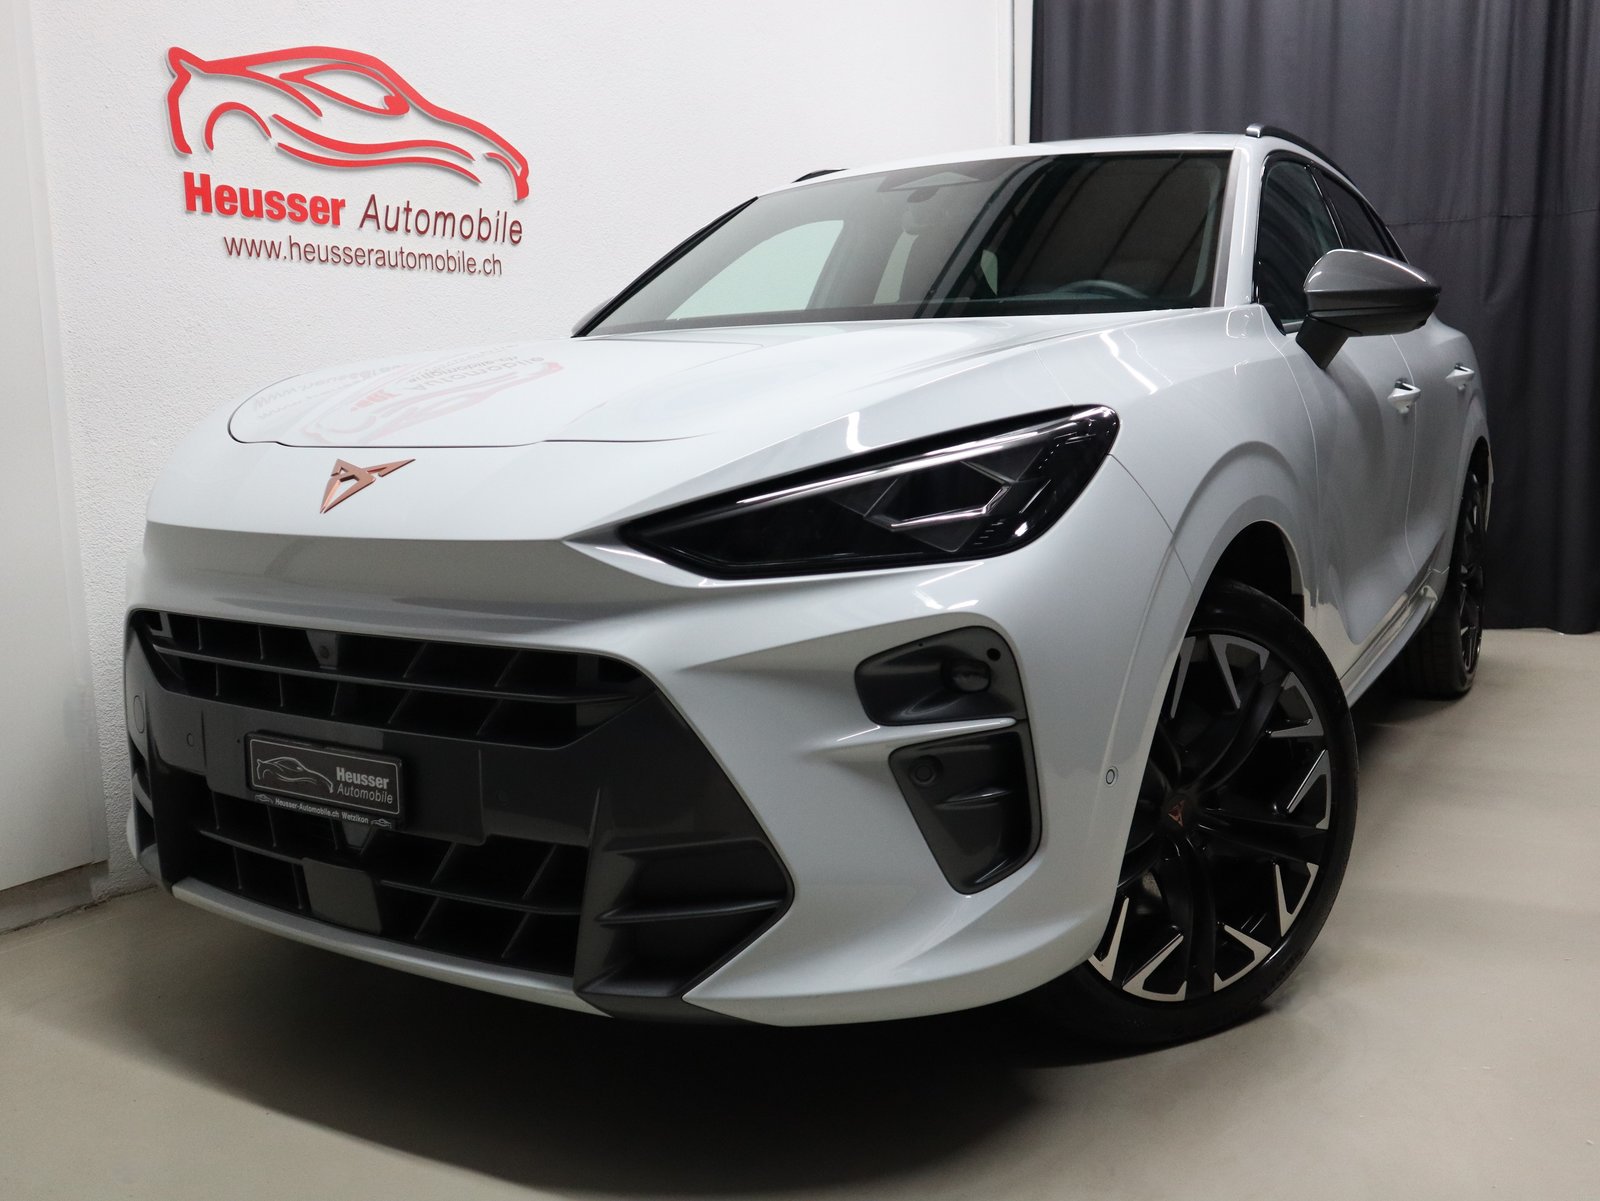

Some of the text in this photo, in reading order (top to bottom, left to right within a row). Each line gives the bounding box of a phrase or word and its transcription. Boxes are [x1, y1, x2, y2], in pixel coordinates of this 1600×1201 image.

[184, 172, 523, 244] Heusser Automobile
[223, 235, 502, 275] www.heusserautomobile.ch
[336, 767, 389, 789] Heusser
[337, 784, 393, 804] Automobile
[275, 798, 369, 824] Heusser-Automobile.ch Wetzikon
